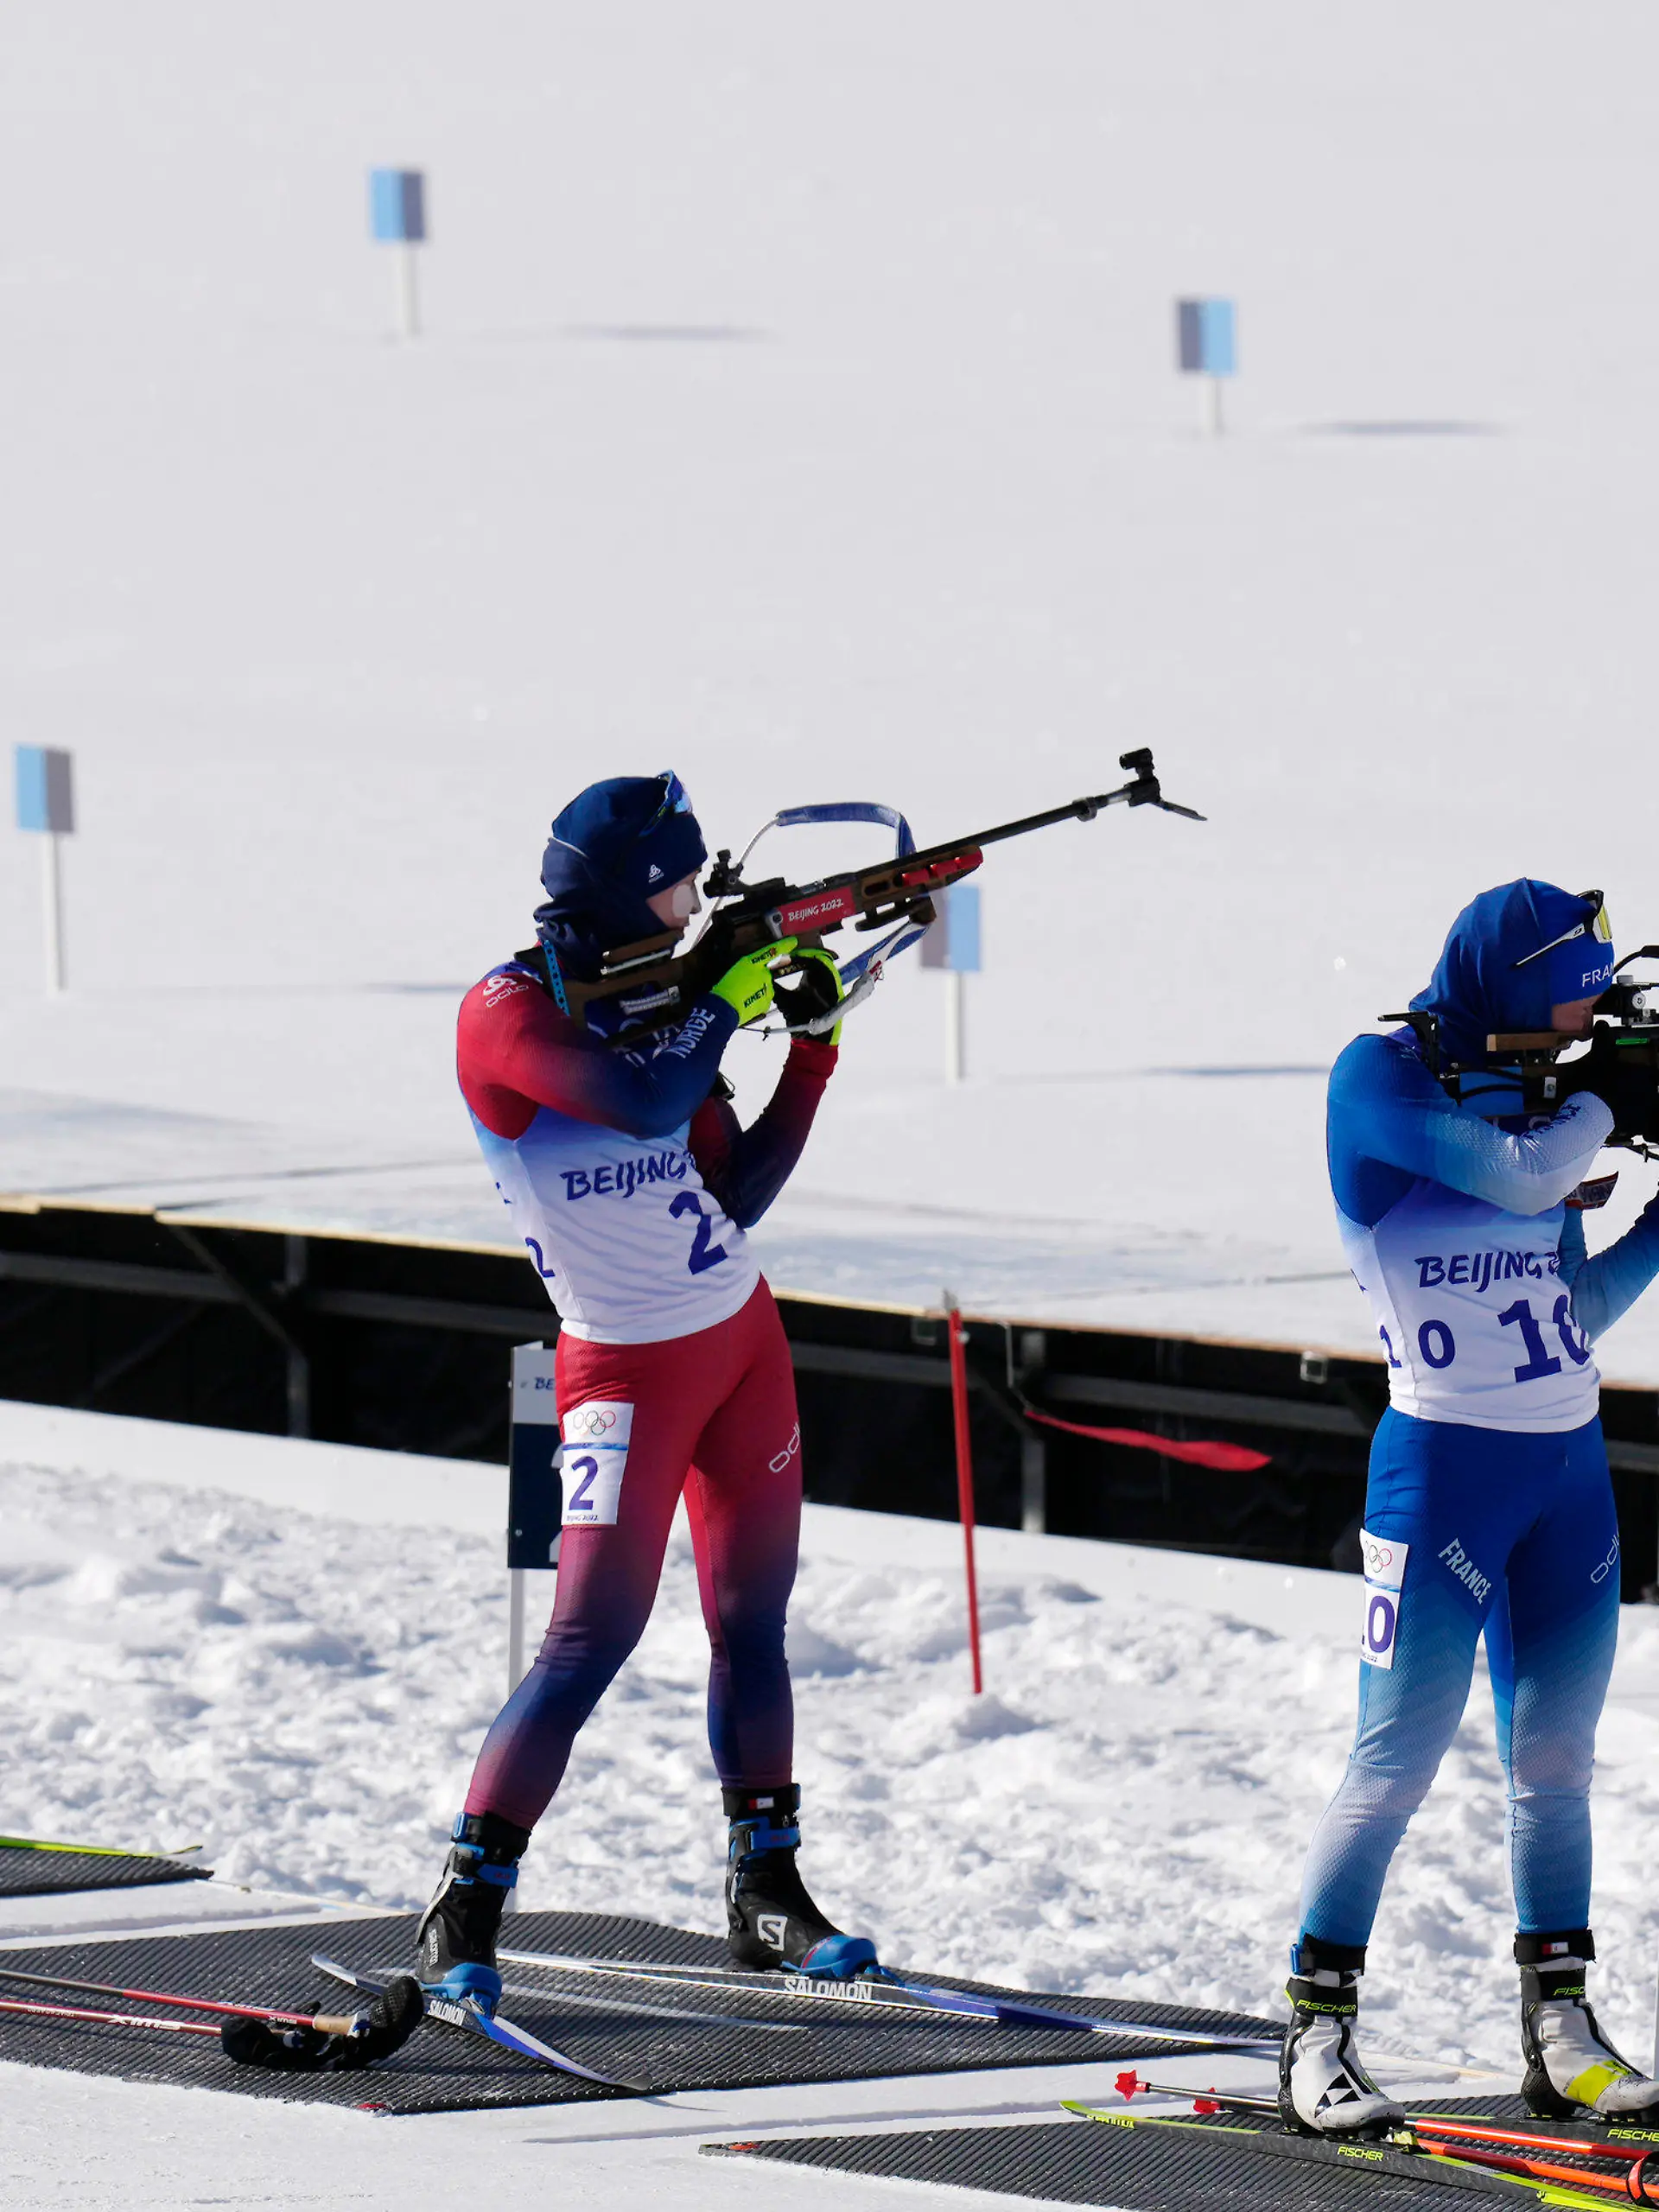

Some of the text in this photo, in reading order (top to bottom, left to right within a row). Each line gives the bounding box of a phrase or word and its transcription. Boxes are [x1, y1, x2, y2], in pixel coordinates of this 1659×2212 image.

[788, 899, 844, 922] BEIJING 2022
[664, 1007, 715, 1058] NORGE
[560, 1151, 686, 1201] BEIJING
[669, 1191, 728, 1275] 2
[524, 1236, 556, 1278] 2
[1414, 1250, 1542, 1294] BEIJING
[1497, 1294, 1590, 1383] 10
[569, 1456, 599, 1511] 2
[1438, 1537, 1494, 1605] FRANCE
[785, 1977, 873, 2000] SALOMON
[1297, 1999, 1357, 2012] FISCHER
[1337, 2145, 1383, 2162] FISCHER
